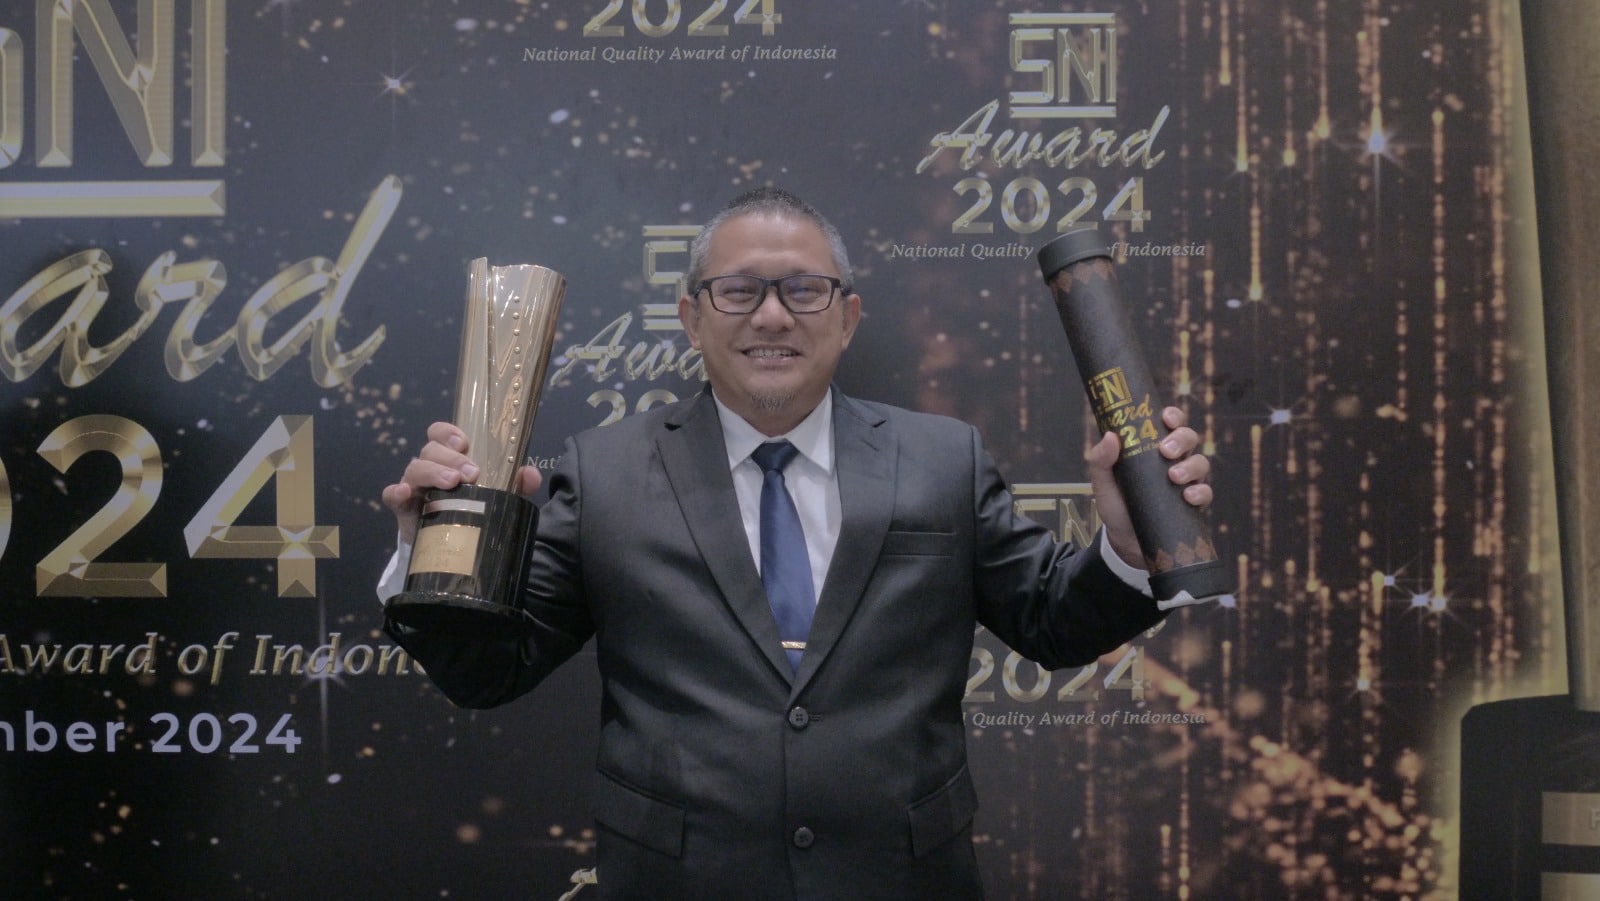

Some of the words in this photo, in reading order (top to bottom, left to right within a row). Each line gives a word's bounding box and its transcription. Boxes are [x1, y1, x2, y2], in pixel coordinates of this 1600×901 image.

[582, 0, 782, 38] 2024
[522, 46, 596, 62] National
[602, 46, 665, 63] Quality
[669, 46, 726, 61] Award
[731, 45, 750, 63] of
[753, 44, 838, 60] Indonesia
[1009, 28, 1116, 103] SNI
[0, 0, 225, 168] NI
[915, 99, 1171, 174] Award
[951, 176, 1152, 234] 2024
[890, 243, 966, 258] National
[971, 242, 1035, 260] Quality
[1122, 242, 1206, 257] Indonesia
[0, 173, 403, 389] ard
[550, 312, 709, 386] Awa
[1119, 418, 1159, 449] 24
[0, 413, 341, 599] 24
[177, 631, 241, 686] of
[249, 631, 428, 677] Indon
[961, 645, 1152, 702] 2024
[149, 711, 302, 754] 2024
[972, 711, 1036, 729] Quality
[1039, 711, 1096, 726] Award
[1100, 710, 1121, 728] of
[1122, 709, 1207, 725] Indonesia
